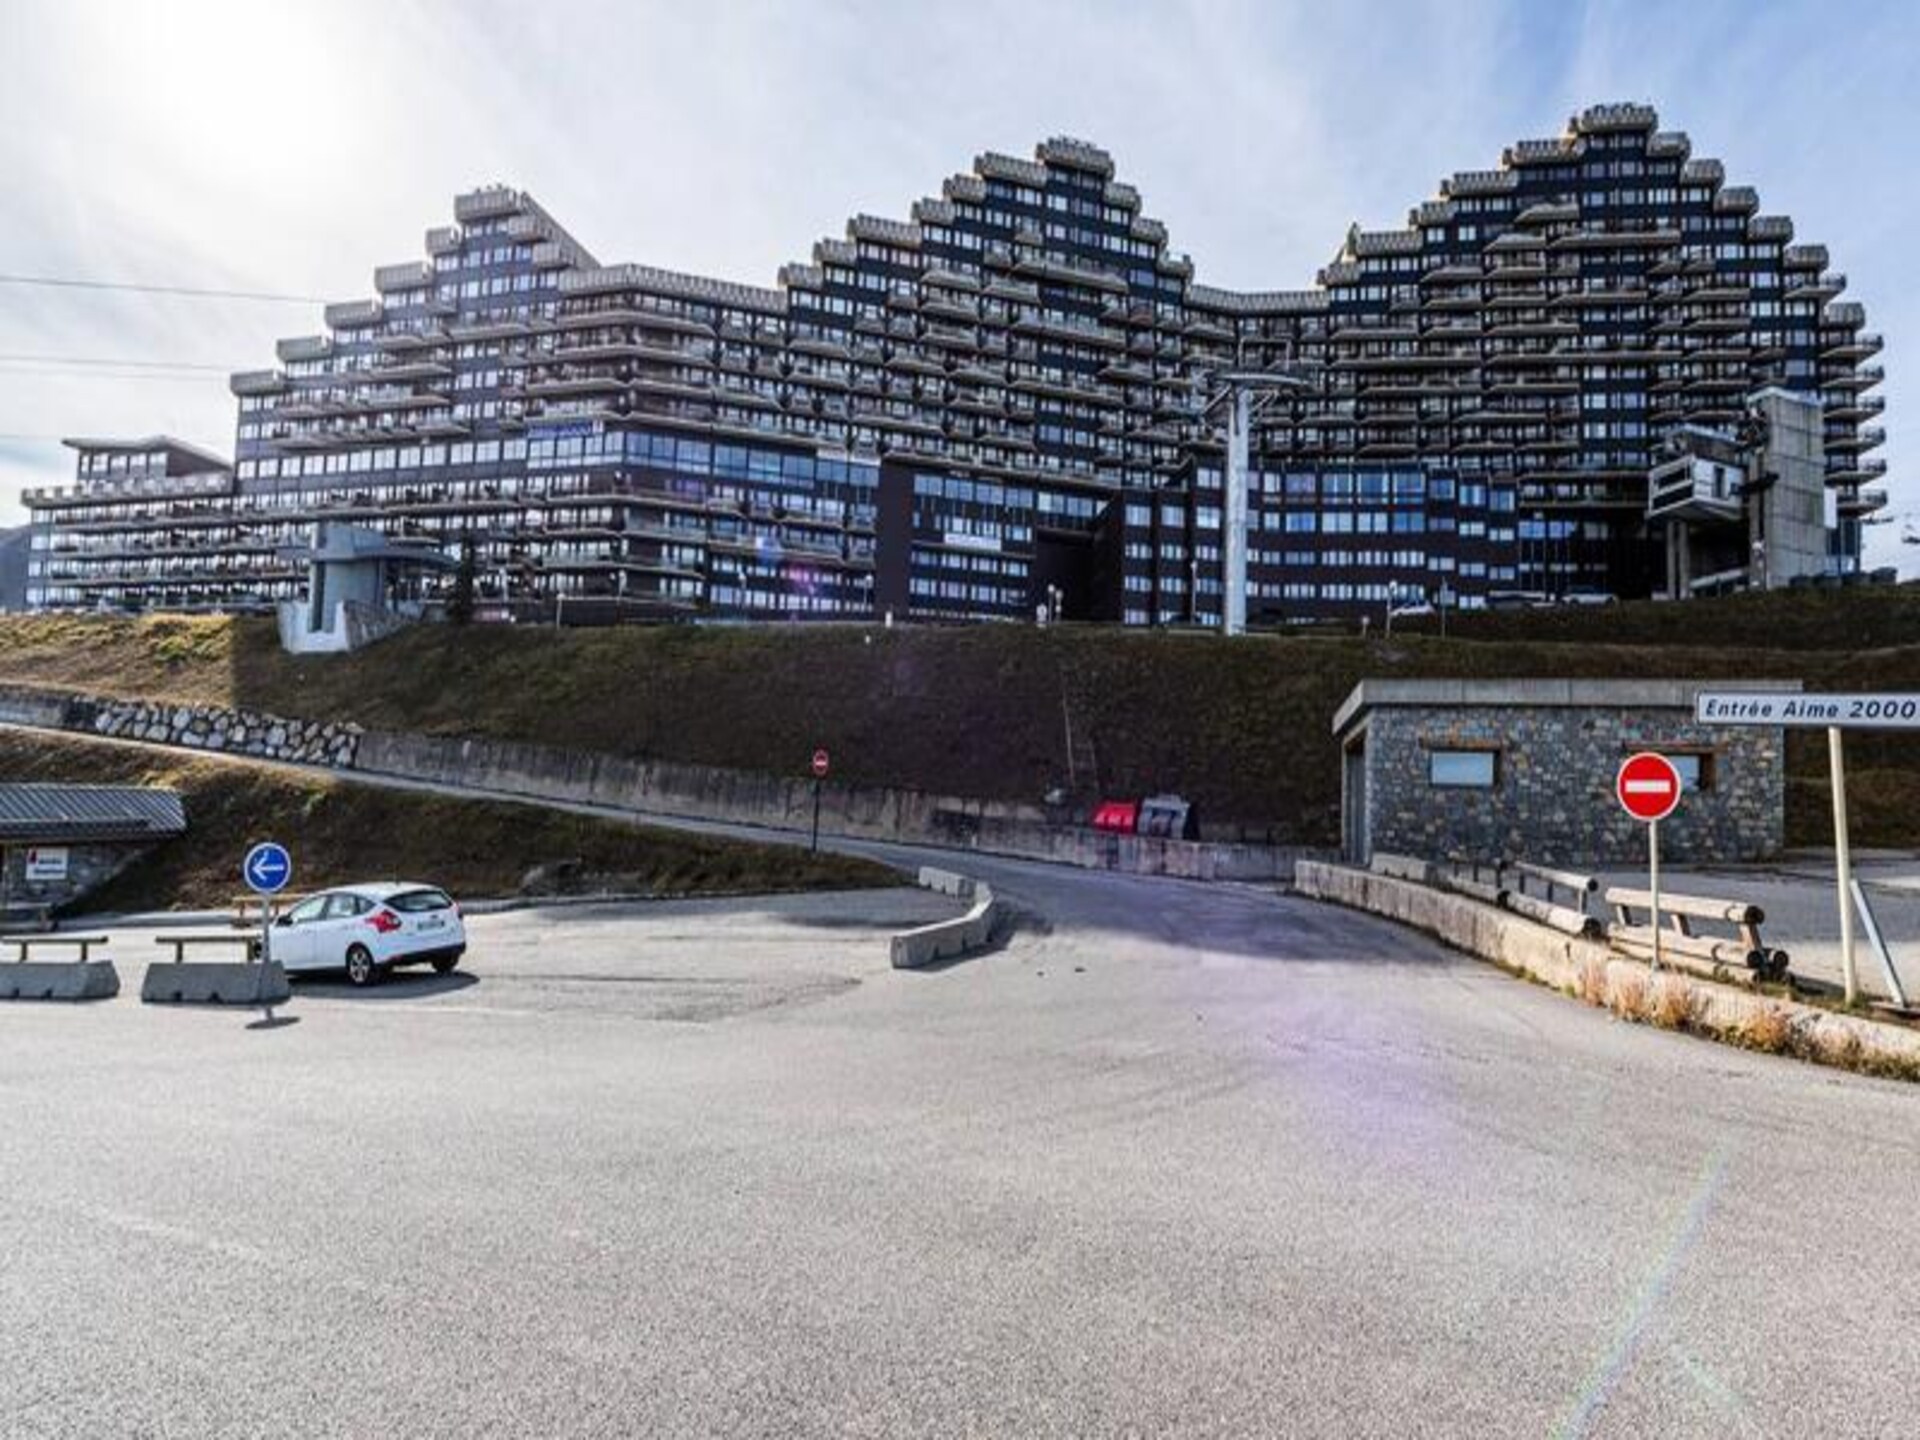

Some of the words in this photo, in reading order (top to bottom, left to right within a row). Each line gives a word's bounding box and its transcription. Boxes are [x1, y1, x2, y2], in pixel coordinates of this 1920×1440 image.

[1706, 699, 1772, 717] Entrée
[1783, 700, 1839, 718] Aime
[1849, 700, 1917, 720] 2000
